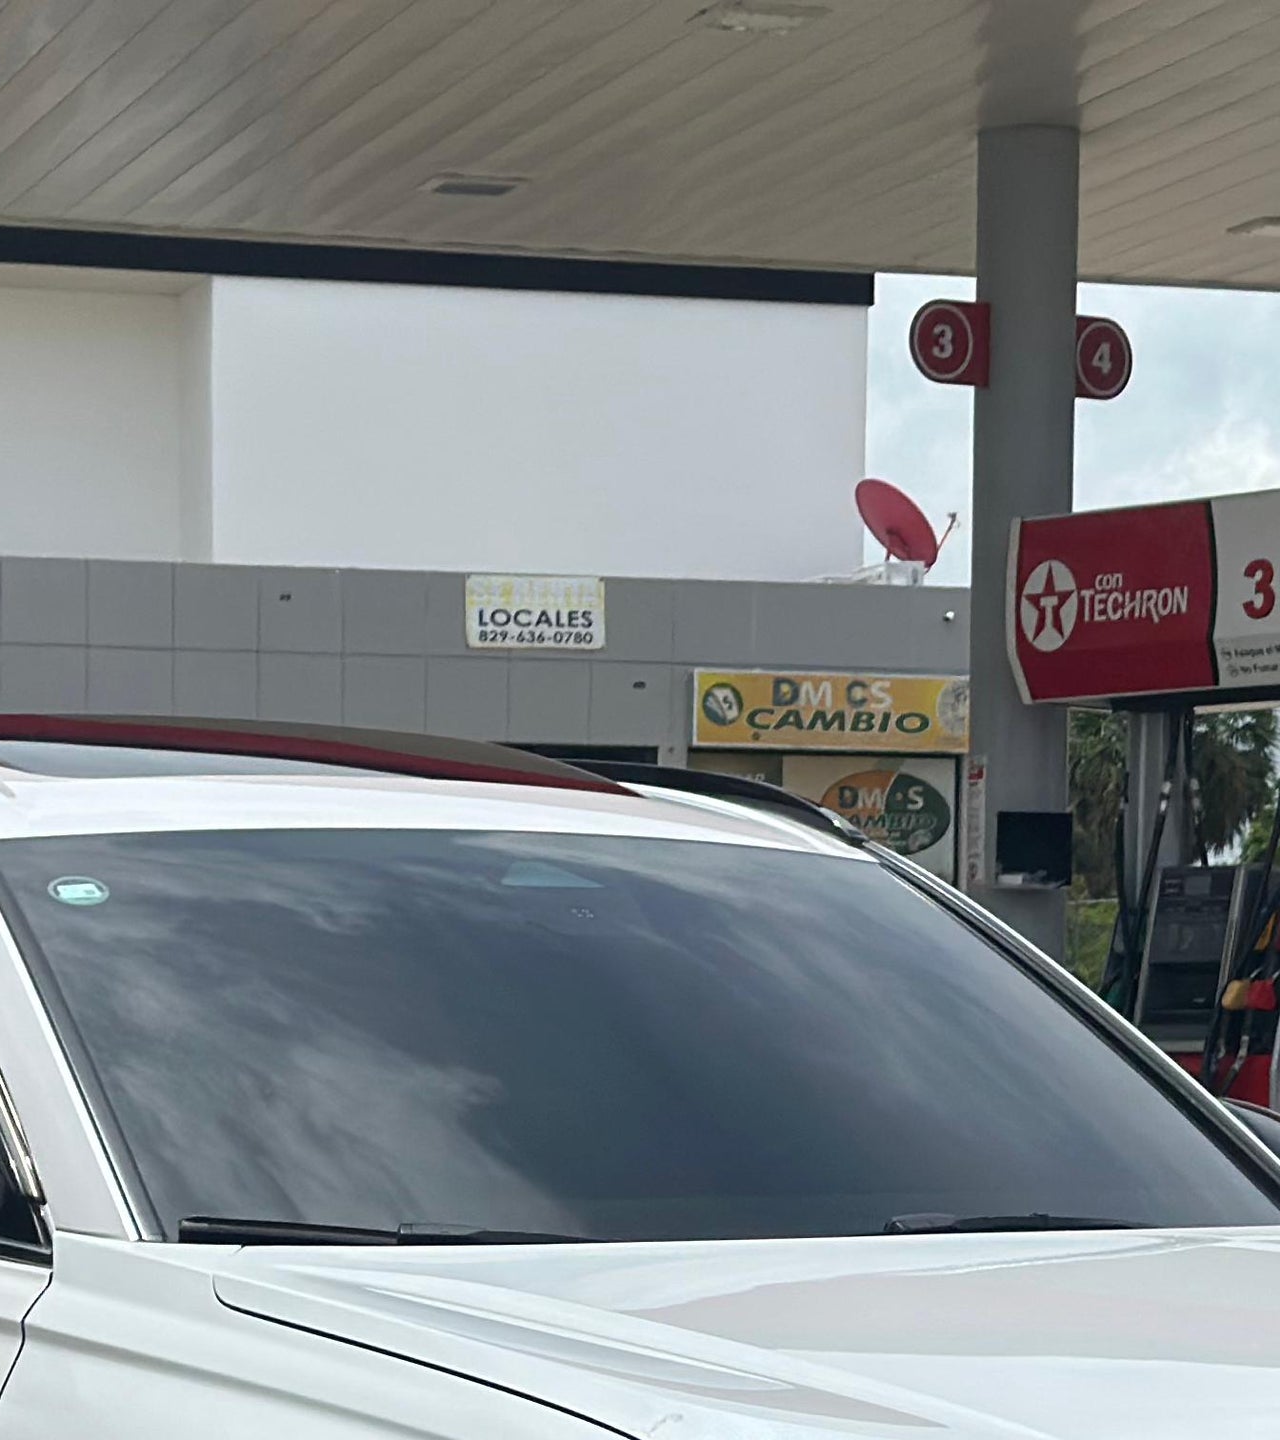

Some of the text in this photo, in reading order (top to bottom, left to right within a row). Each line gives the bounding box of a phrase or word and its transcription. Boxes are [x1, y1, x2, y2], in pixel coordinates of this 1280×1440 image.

[932, 323, 954, 359] 3
[1091, 341, 1113, 375] 4
[1080, 585, 1189, 624] TECHRON
[1242, 558, 1276, 620] 3
[478, 608, 594, 628] LOCALES
[478, 630, 594, 645] 829-636-0780
[772, 678, 834, 708] DM
[745, 708, 931, 734] CAMBIO
